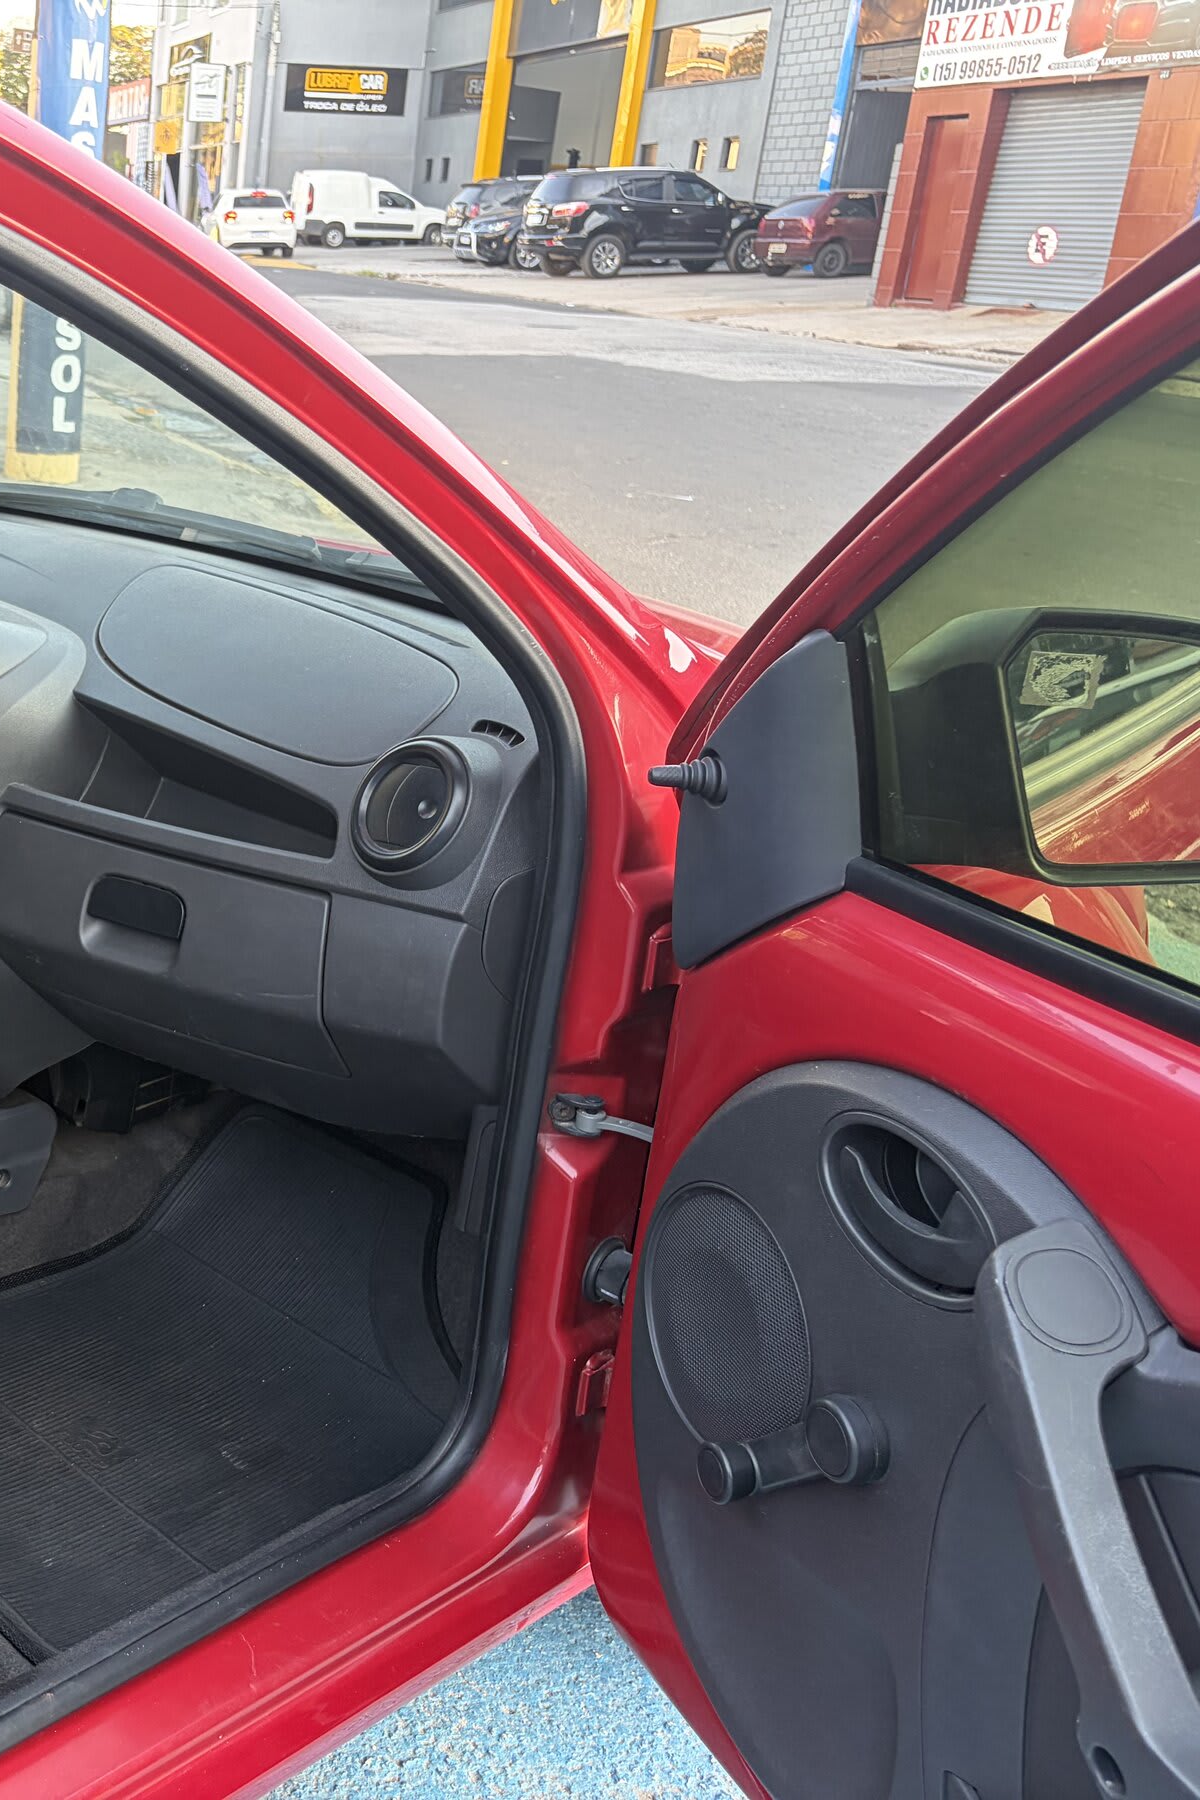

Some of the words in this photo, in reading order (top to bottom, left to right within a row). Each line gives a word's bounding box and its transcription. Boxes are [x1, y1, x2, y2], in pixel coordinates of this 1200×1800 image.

[924, 3, 1065, 46] REZENDE
[933, 62, 957, 82] (15)
[958, 53, 1042, 80] 99855-0512
[303, 100, 338, 110] TROCA
[339, 102, 356, 111] DE
[355, 101, 388, 112] ÓLEO
